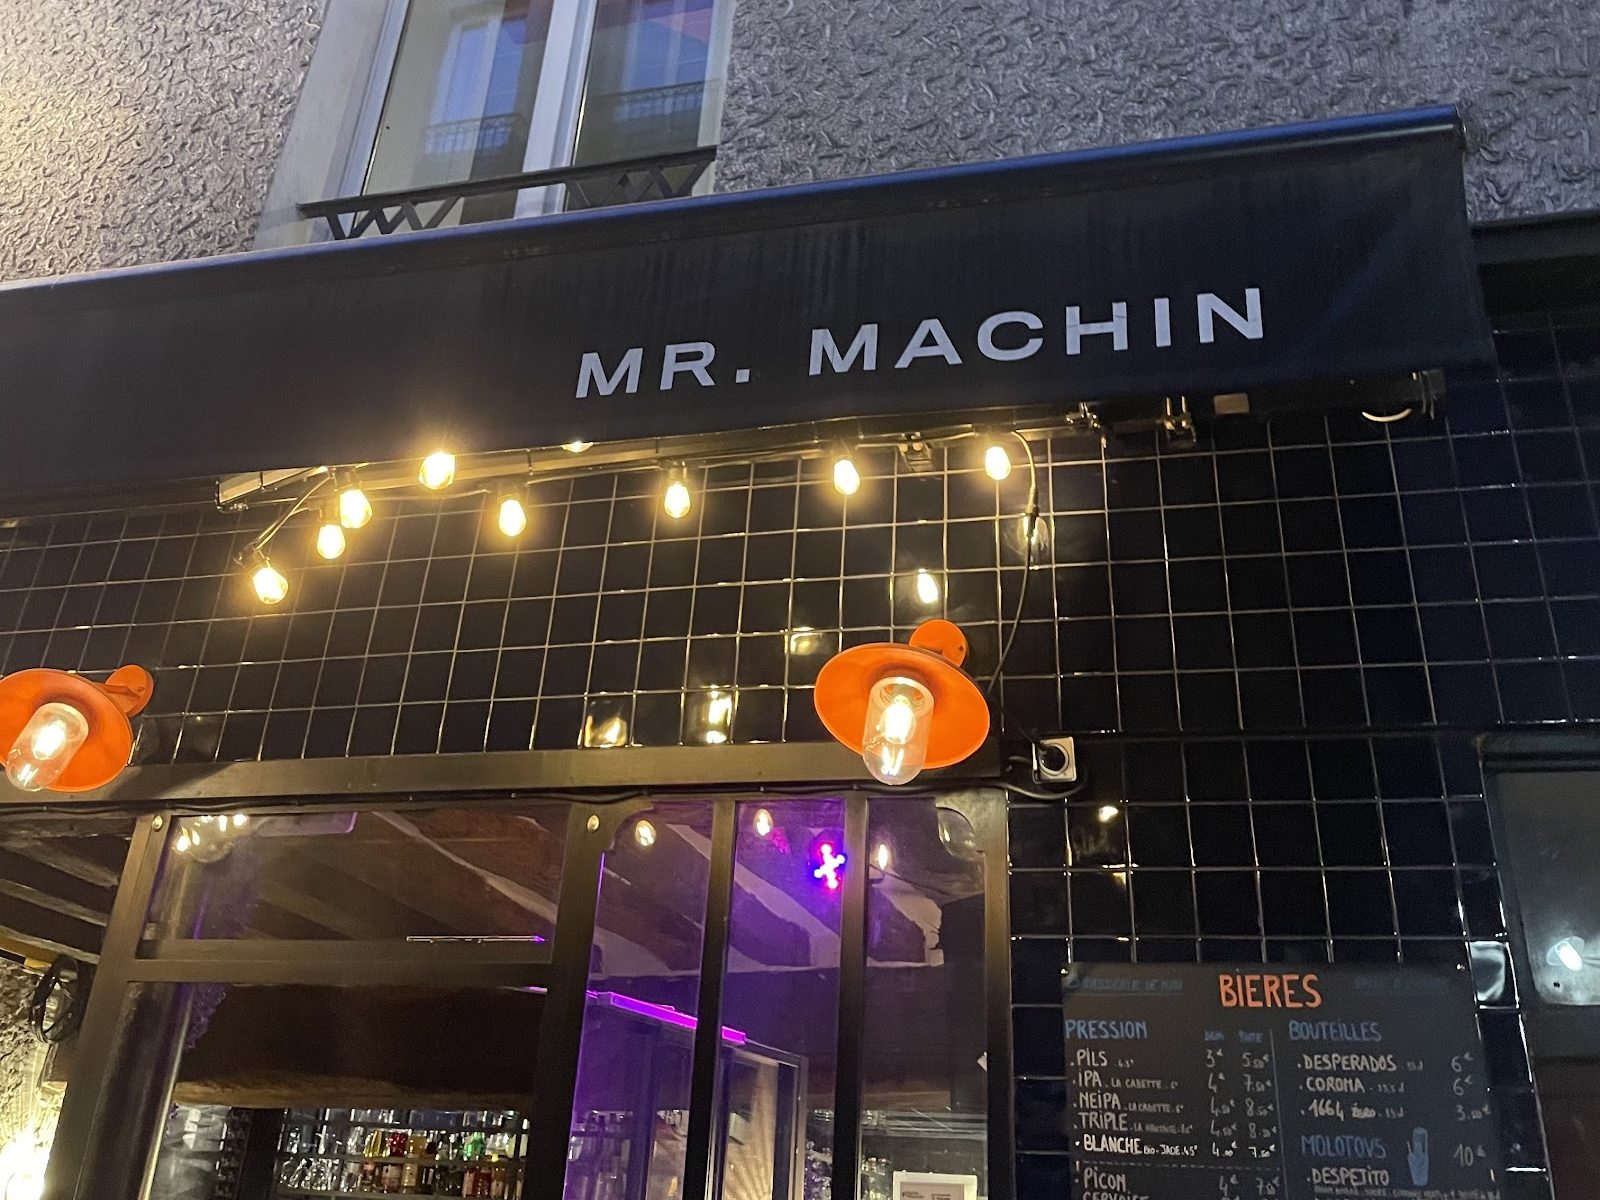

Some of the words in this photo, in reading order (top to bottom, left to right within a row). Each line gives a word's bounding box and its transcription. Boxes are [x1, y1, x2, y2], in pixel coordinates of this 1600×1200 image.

[574, 340, 751, 399] MR.
[808, 287, 1266, 377] MACHIN
[1064, 1019, 1148, 1040] PRESSION
[1288, 1018, 1382, 1042] BOUTEILLES
[1076, 1047, 1108, 1067] PILS
[1302, 1053, 1397, 1073] DESPERADOS
[1305, 1075, 1366, 1093] CORONA
[1308, 1098, 1345, 1121] 1664
[1079, 1110, 1128, 1131] TRIPLE
[1083, 1134, 1143, 1155] BLANCHE
[1300, 1134, 1388, 1159] MOLOTOVS
[1083, 1166, 1127, 1193] PICON
